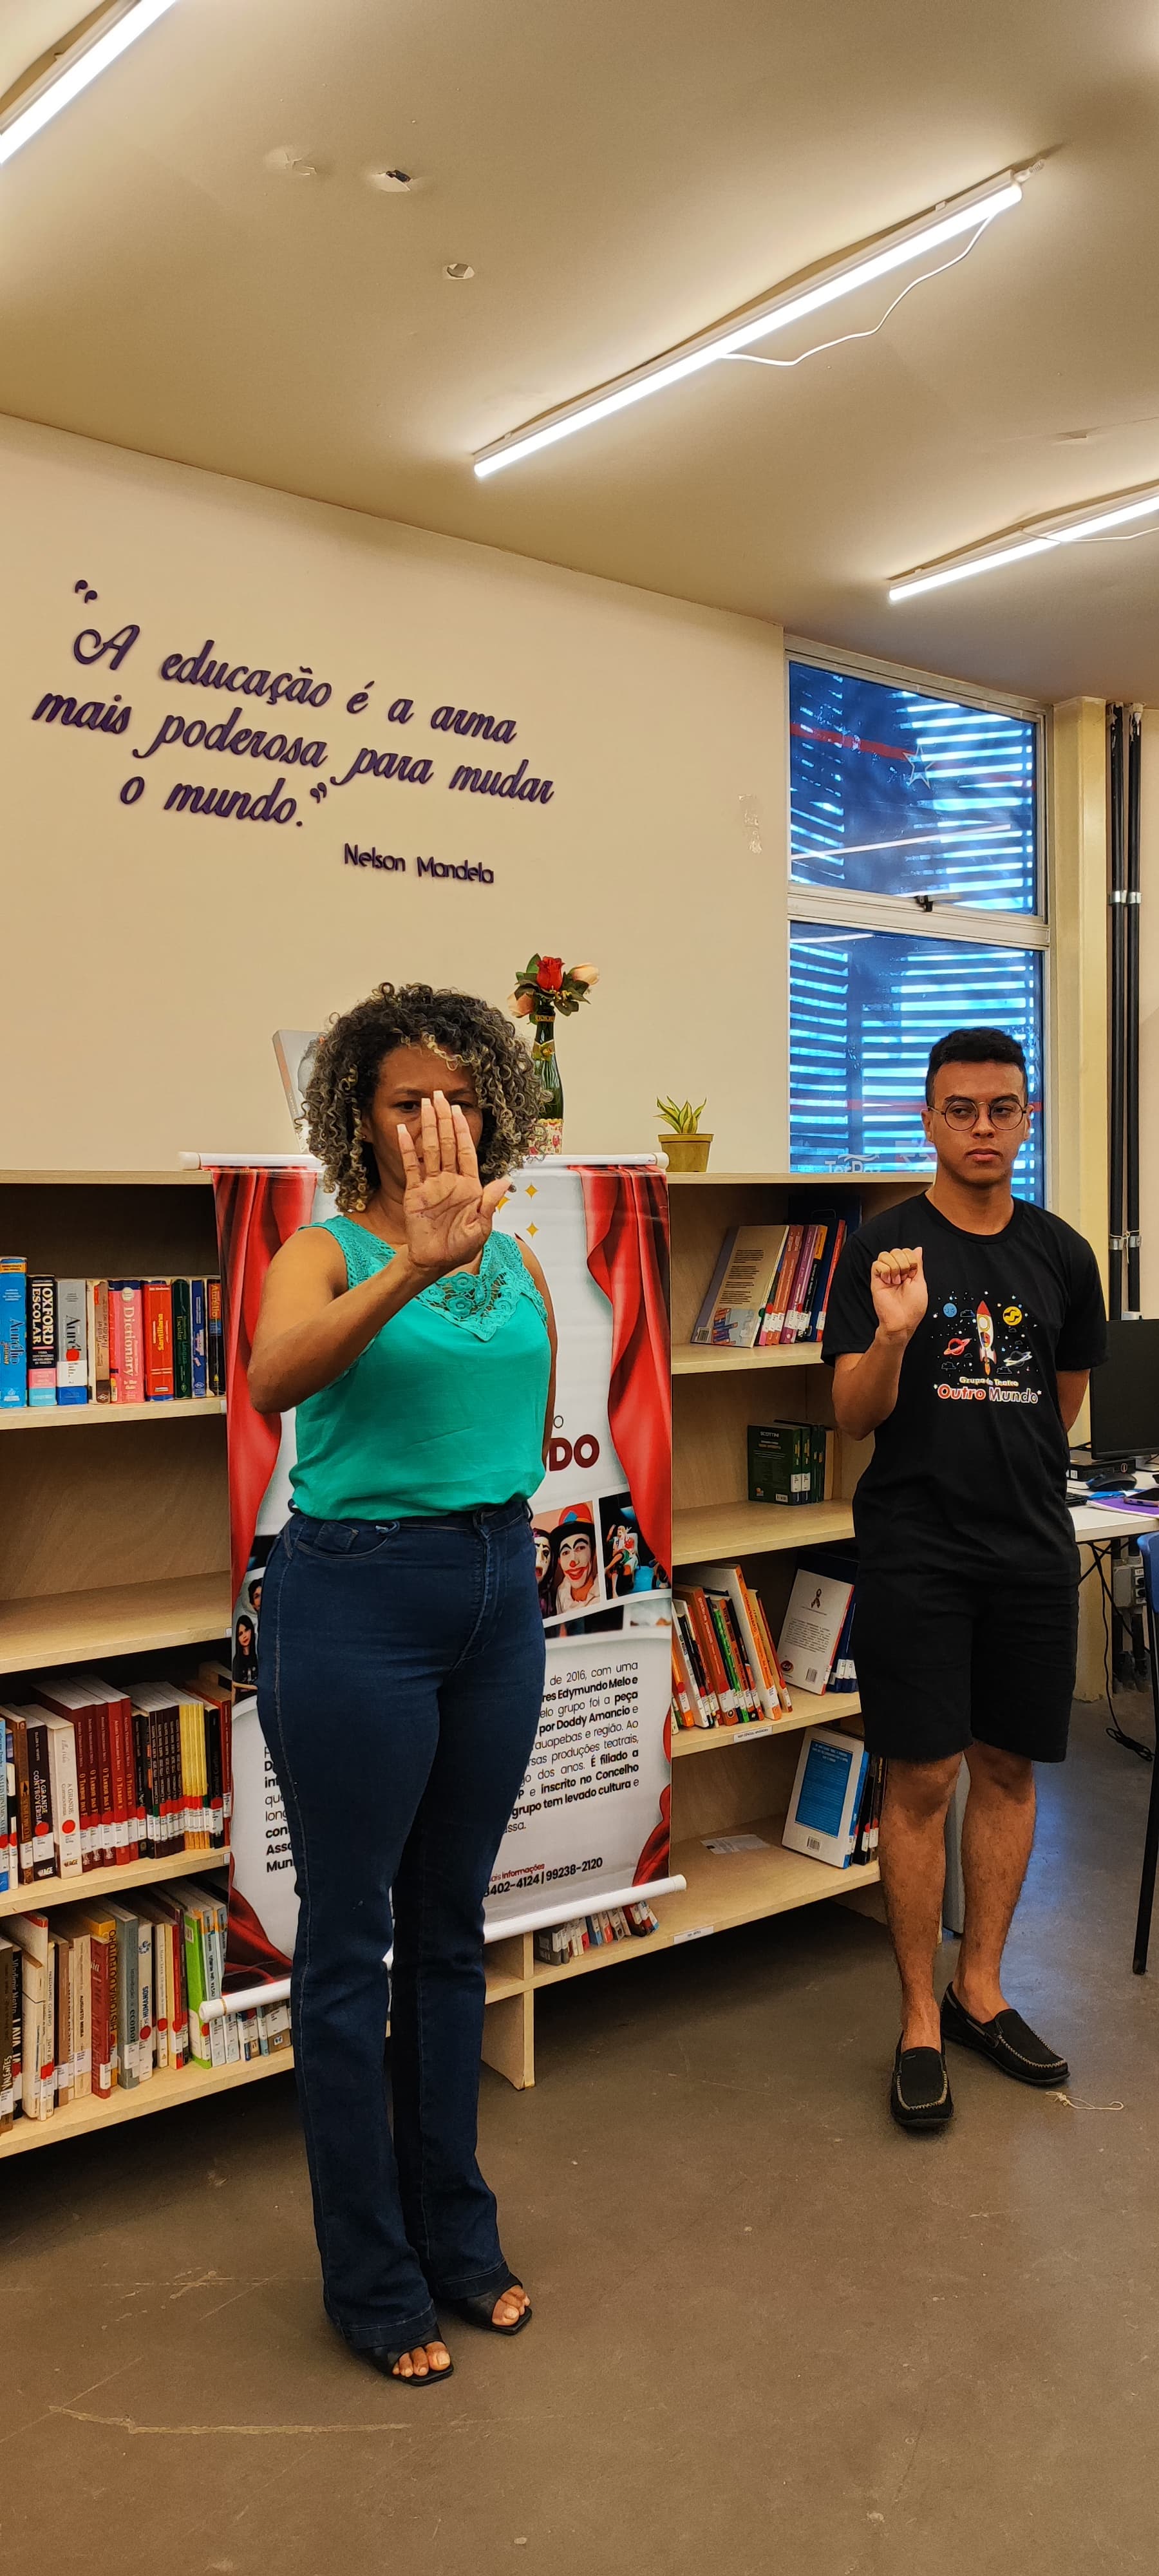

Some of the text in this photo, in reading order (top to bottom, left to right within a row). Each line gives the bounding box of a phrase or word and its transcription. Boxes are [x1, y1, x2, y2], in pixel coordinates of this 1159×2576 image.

[73, 625, 517, 744] A educação é a arma
[32, 693, 554, 804] mais poderosa para mudar
[120, 777, 145, 805] o
[344, 843, 494, 884] Nelson Mandela
[32, 1287, 42, 1345] ESCOLAR
[42, 1287, 54, 1345] OXFORD
[10, 1318, 25, 1365] Aurélio
[123, 1307, 135, 1376] Dictionary
[156, 1313, 165, 1351] Santillana
[938, 1384, 1039, 1404] Outro Mundo
[959, 1376, 986, 1385] Grupo
[550, 1662, 638, 1685] de 2016, com uma
[558, 1682, 608, 1700] Edymundo
[608, 1677, 631, 1689] Melo
[558, 1702, 585, 1717] grupo
[614, 1691, 638, 1705] peça
[533, 1720, 639, 1750] auapebas e região. Ao
[538, 1723, 555, 1737] por
[557, 1715, 587, 1730] Doddy
[589, 1706, 630, 1723] Amancio
[538, 1769, 556, 1780] dos
[560, 1763, 586, 1775] anos.
[590, 1755, 597, 1768] É
[599, 1751, 628, 1765] filiado
[632, 1749, 639, 1758] a
[551, 1743, 601, 1765] produções
[604, 1734, 639, 1749] teatrais,
[529, 1788, 536, 1797] e
[541, 1779, 576, 1794] inscrito
[580, 1775, 592, 1785] no
[596, 1764, 639, 1781] Concelho
[512, 1779, 639, 1820] grupo tem levado cultura e
[505, 1822, 527, 1833] ssa.
[489, 1873, 501, 1883] ais
[546, 1857, 603, 1881] 99238-2120
[3, 2055, 12, 2090] VALENTES
